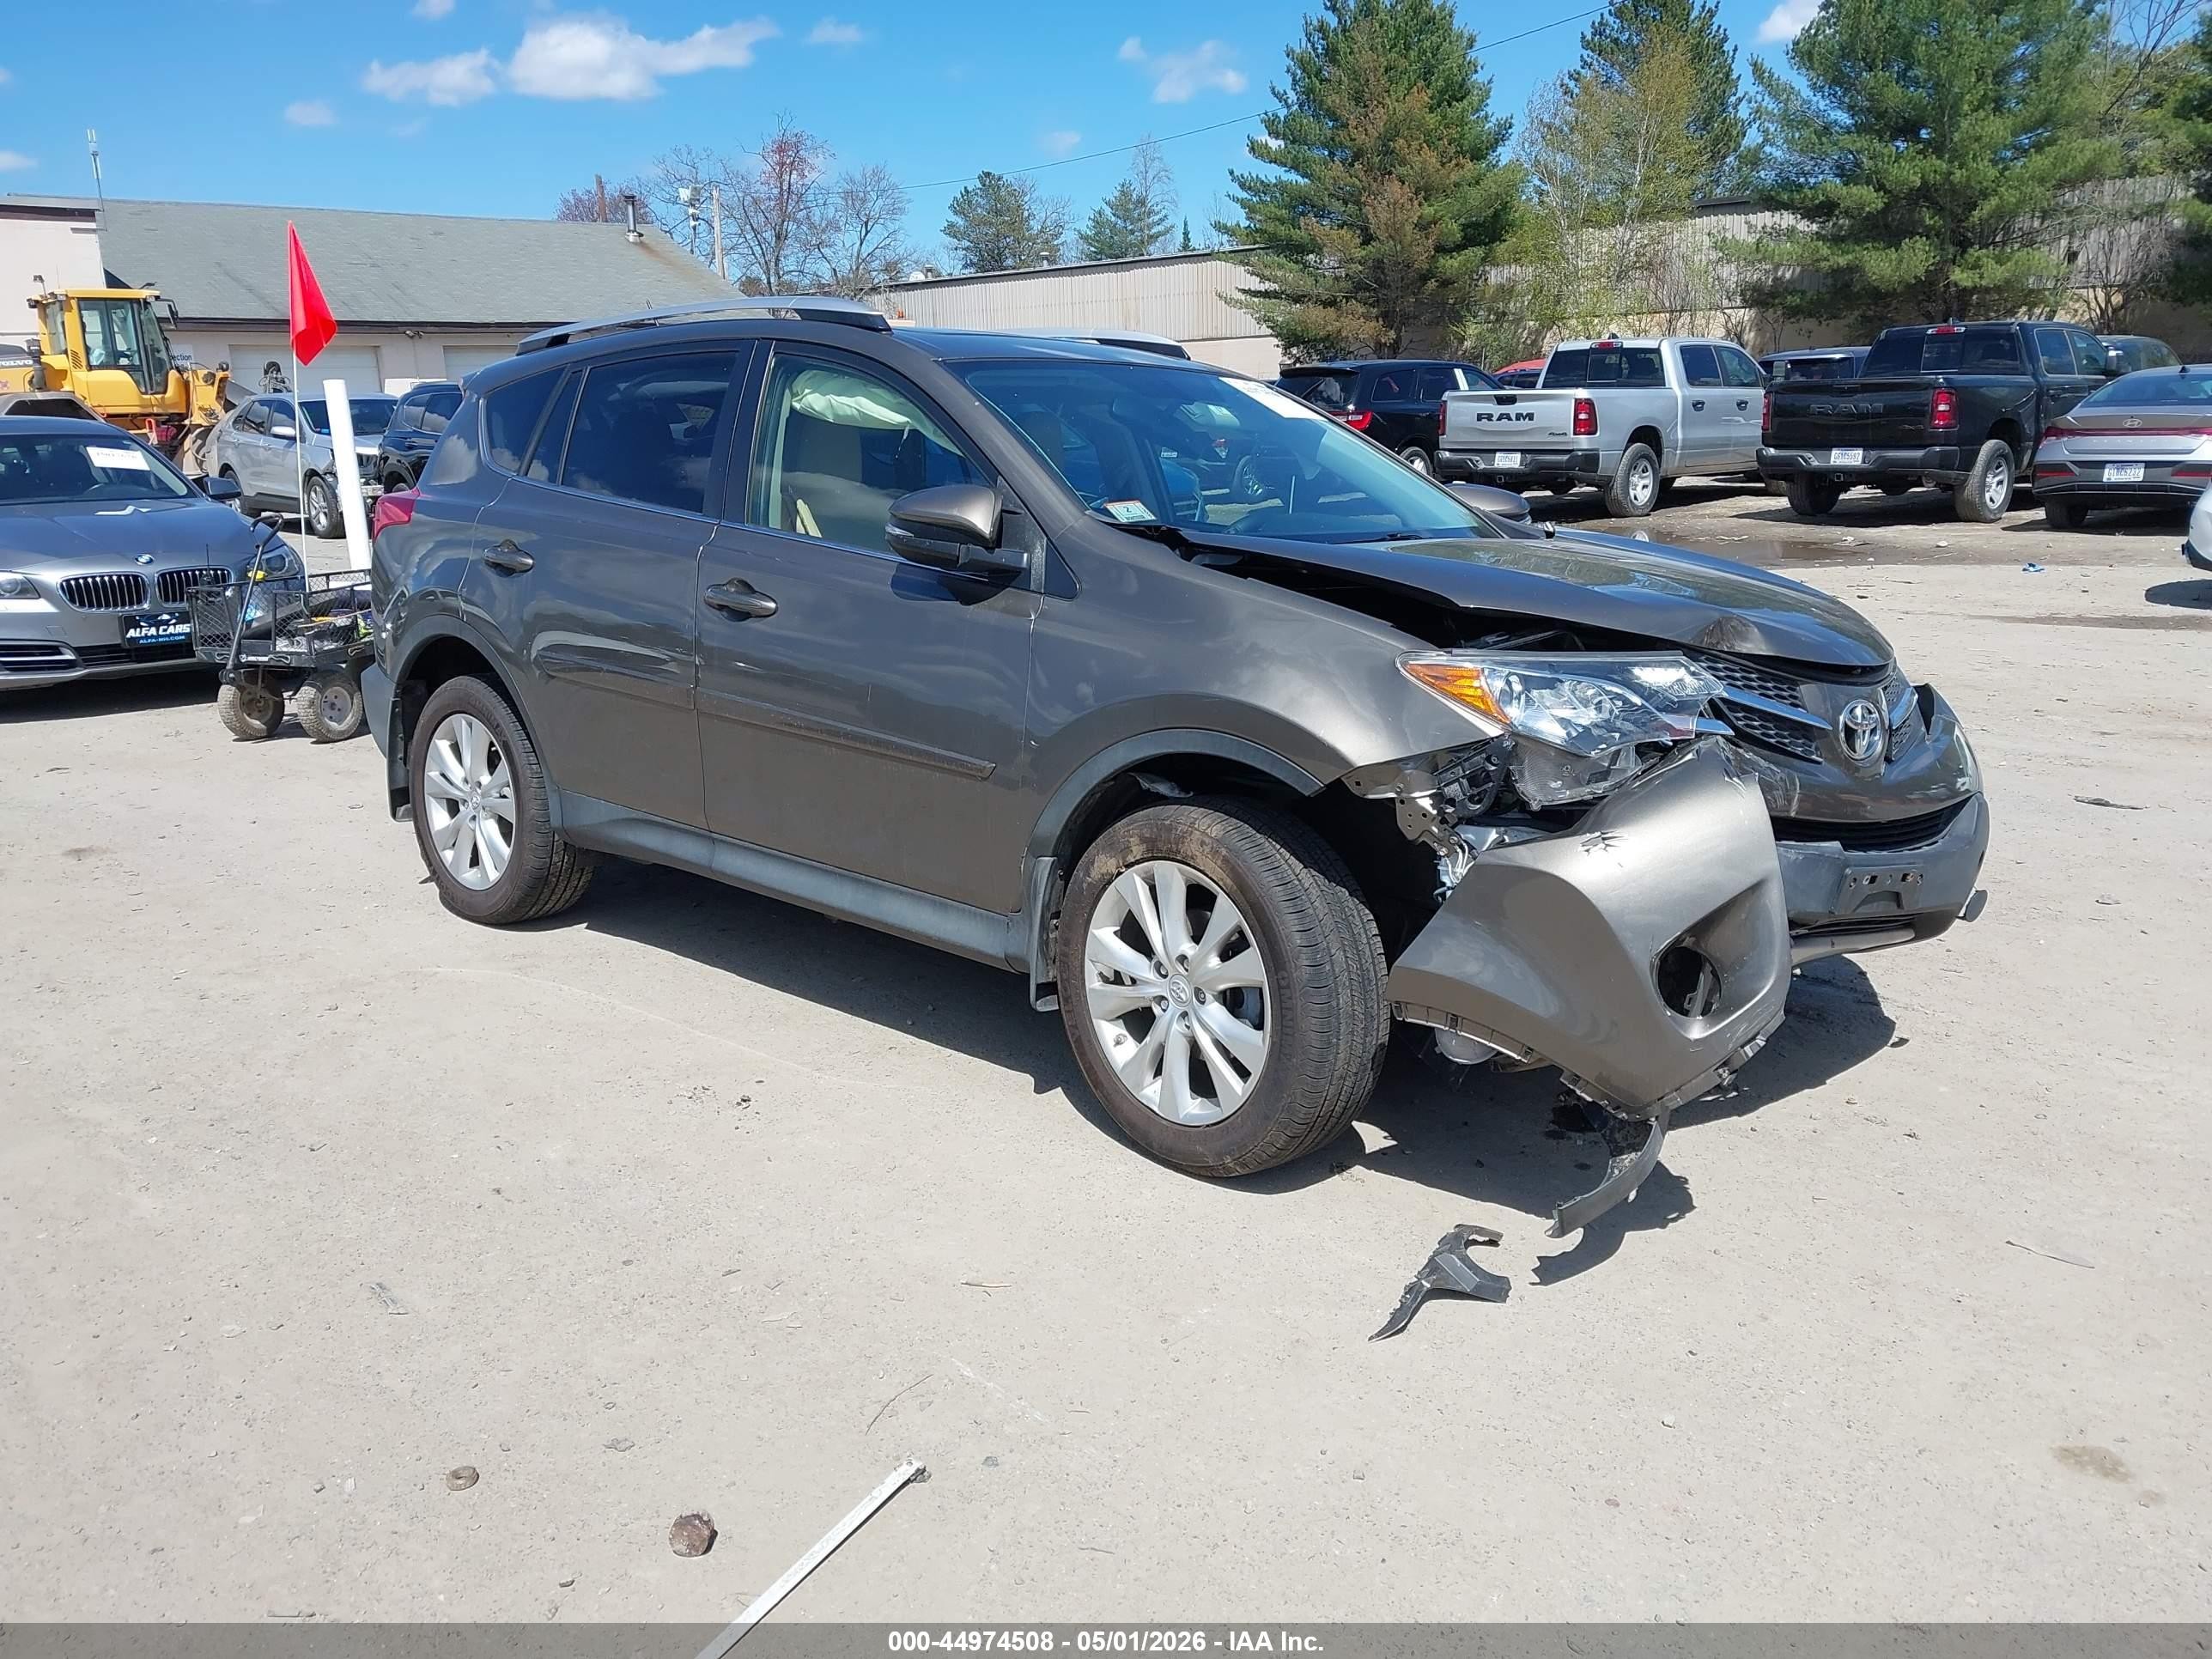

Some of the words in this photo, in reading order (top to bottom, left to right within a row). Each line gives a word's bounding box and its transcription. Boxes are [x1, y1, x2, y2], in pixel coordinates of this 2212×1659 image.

[1809, 404, 1883, 414] RAM
[1476, 412, 1535, 422] RAM
[125, 626, 157, 638] ALFA
[158, 623, 191, 635] CARS
